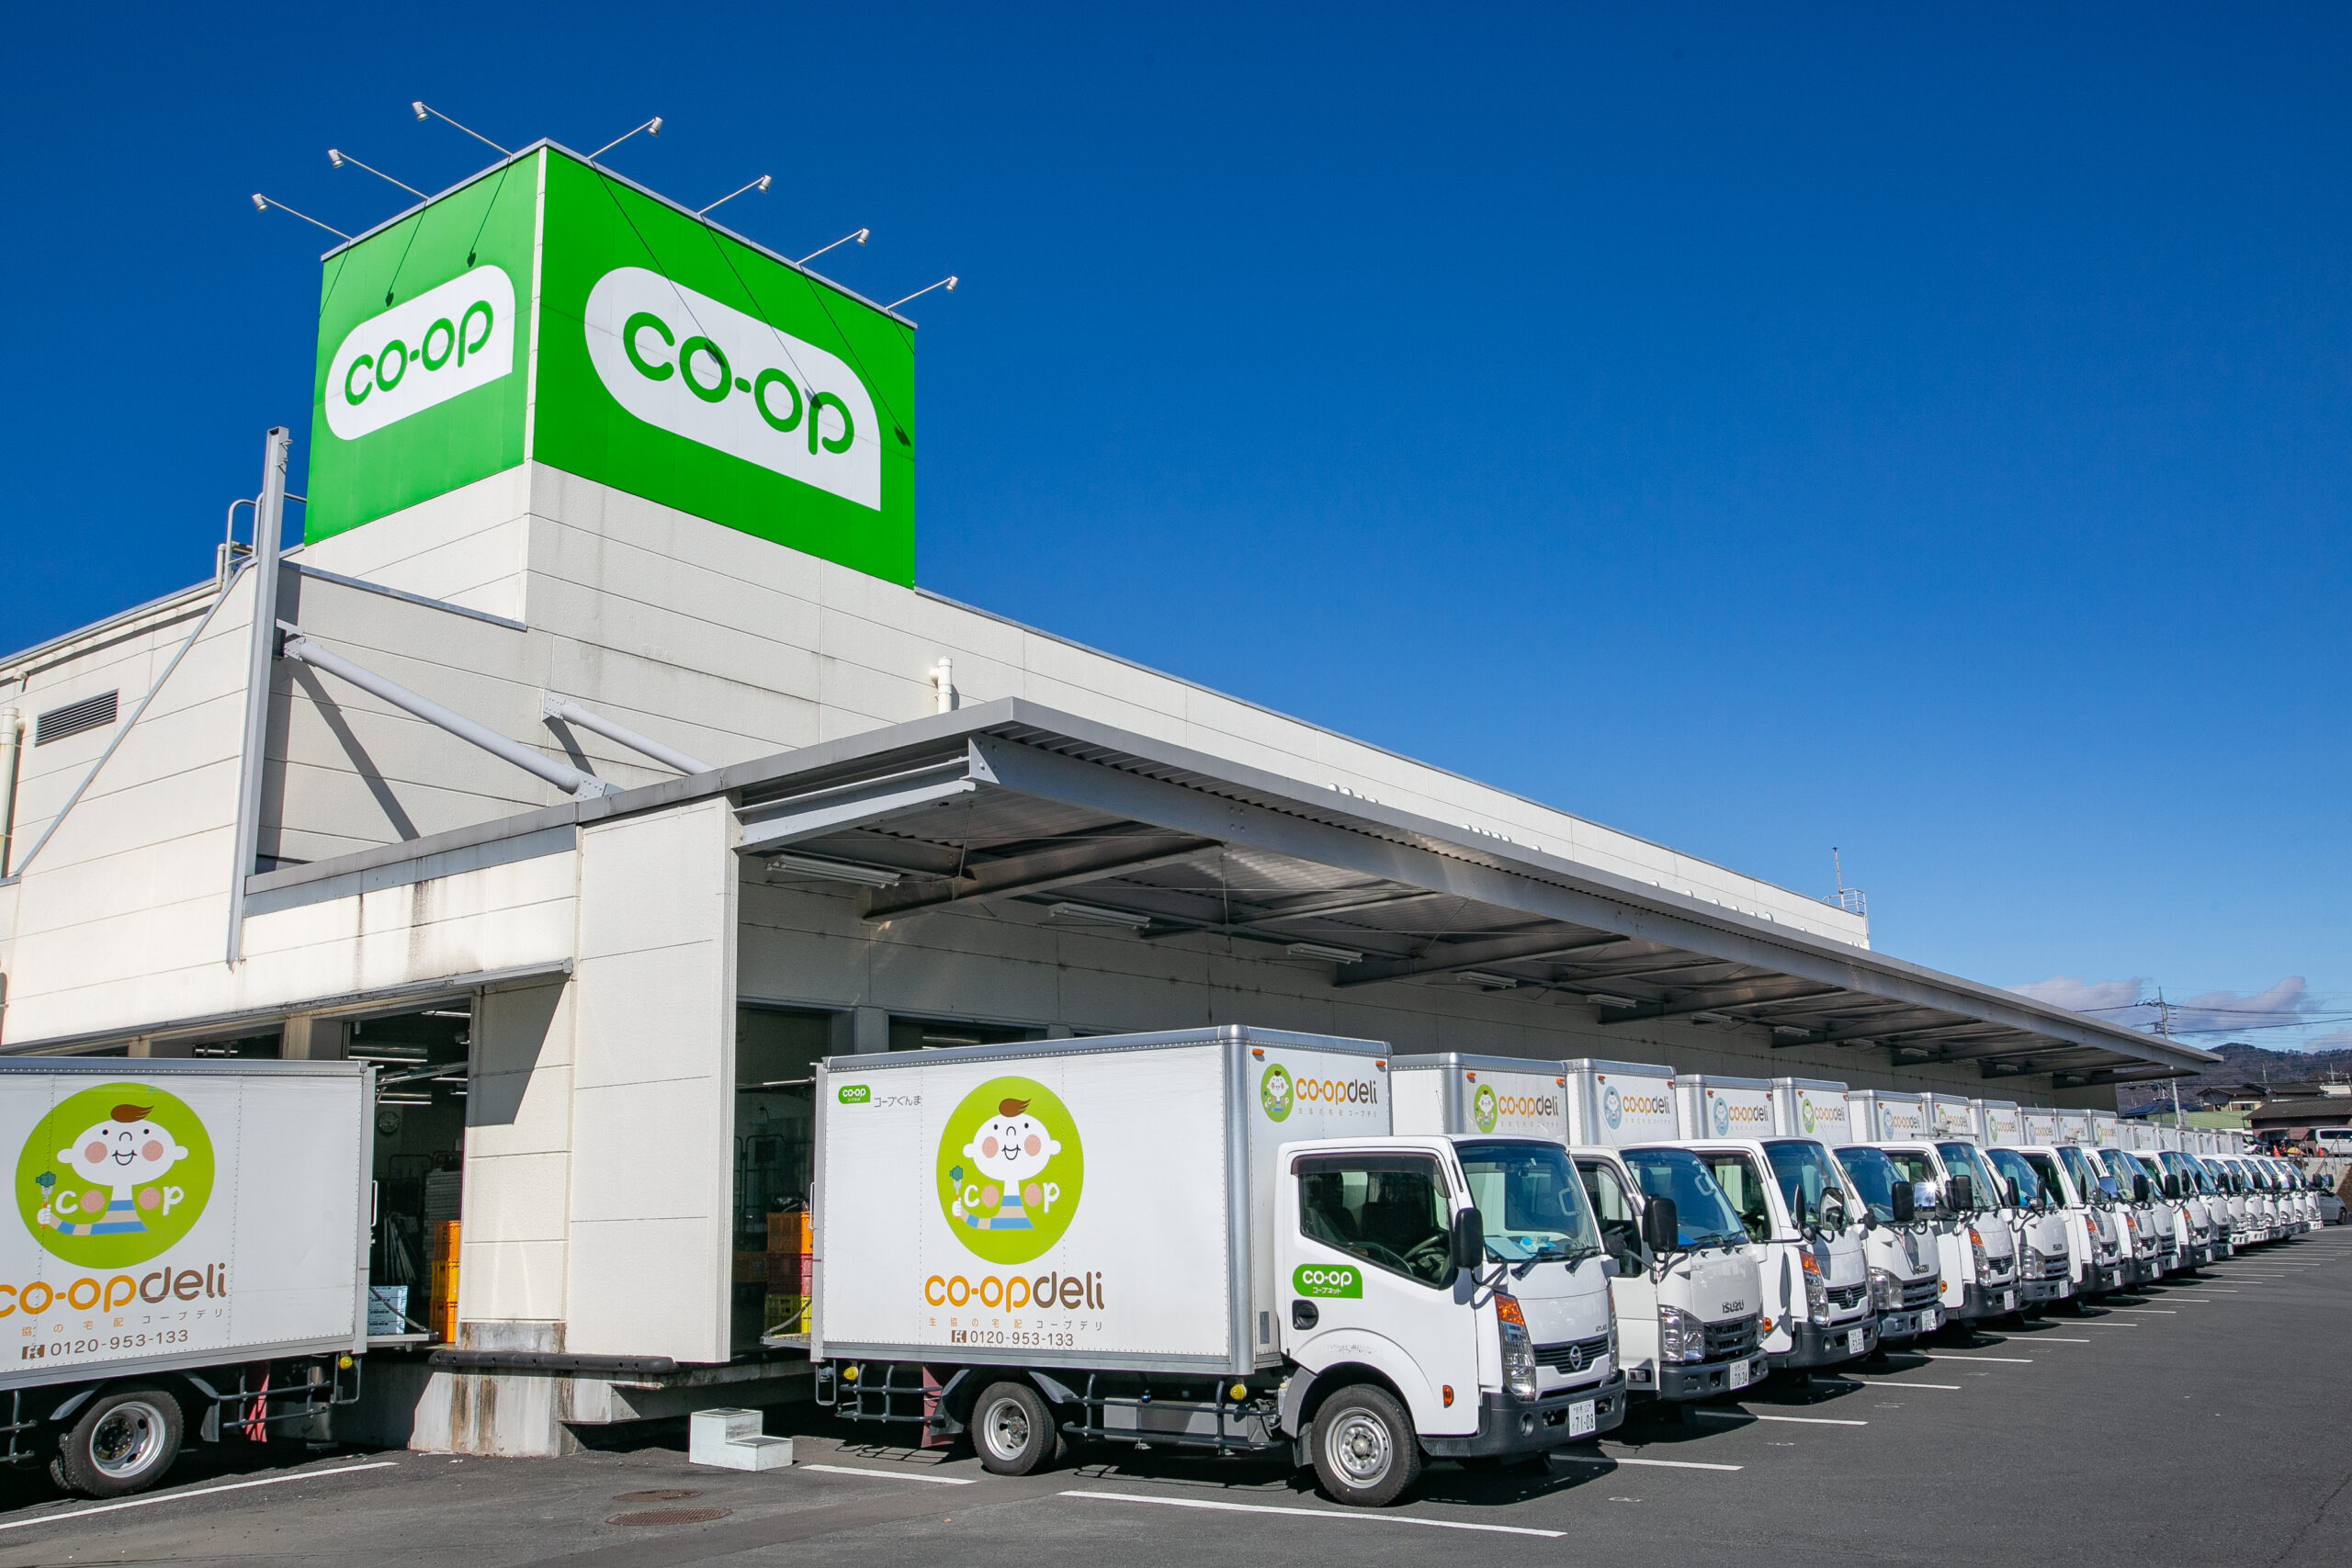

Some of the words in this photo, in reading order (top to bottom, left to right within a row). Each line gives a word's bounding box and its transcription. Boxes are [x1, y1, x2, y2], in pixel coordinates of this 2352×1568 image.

[345, 300, 493, 407] co-op
[623, 311, 854, 455] co-op
[842, 1089, 865, 1098] co-op
[1296, 1078, 1377, 1105] co-opdeli
[874, 1095, 922, 1108] コープぐんま
[1498, 1095, 1559, 1118] co-opdeli
[1623, 1096, 1670, 1116] co-opdeli
[1728, 1105, 1769, 1122] co-opdeli
[1303, 1270, 1352, 1287] co-op
[924, 1271, 1104, 1313] co-opdeli
[1723, 1300, 1744, 1314] ISUZU
[1596, 1325, 1607, 1333] ATLAS
[51, 1329, 188, 1357] 0120-953-133
[970, 1330, 1074, 1347] 0120-953-133
